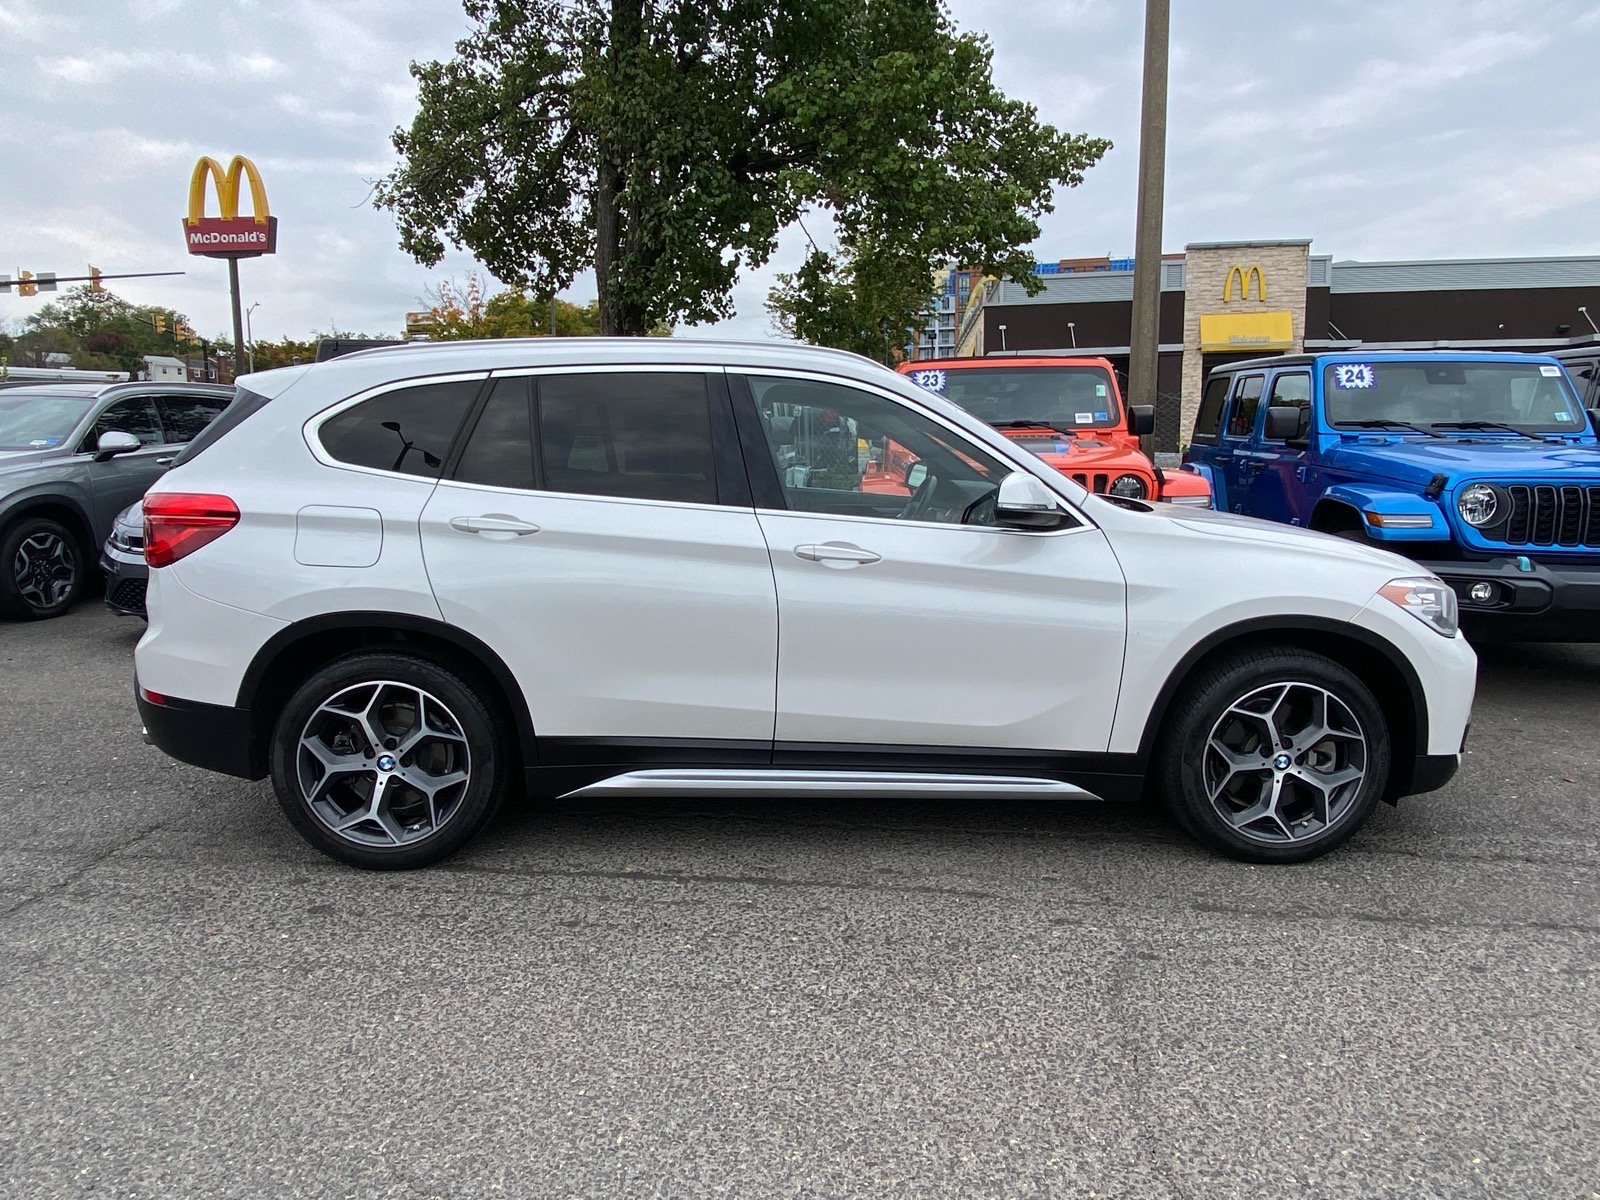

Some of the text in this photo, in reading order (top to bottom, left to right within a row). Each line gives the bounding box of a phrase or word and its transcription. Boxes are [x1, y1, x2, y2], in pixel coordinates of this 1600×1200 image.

[190, 231, 267, 244] McDonald's
[922, 374, 939, 387] 23
[1344, 369, 1365, 383] 24
